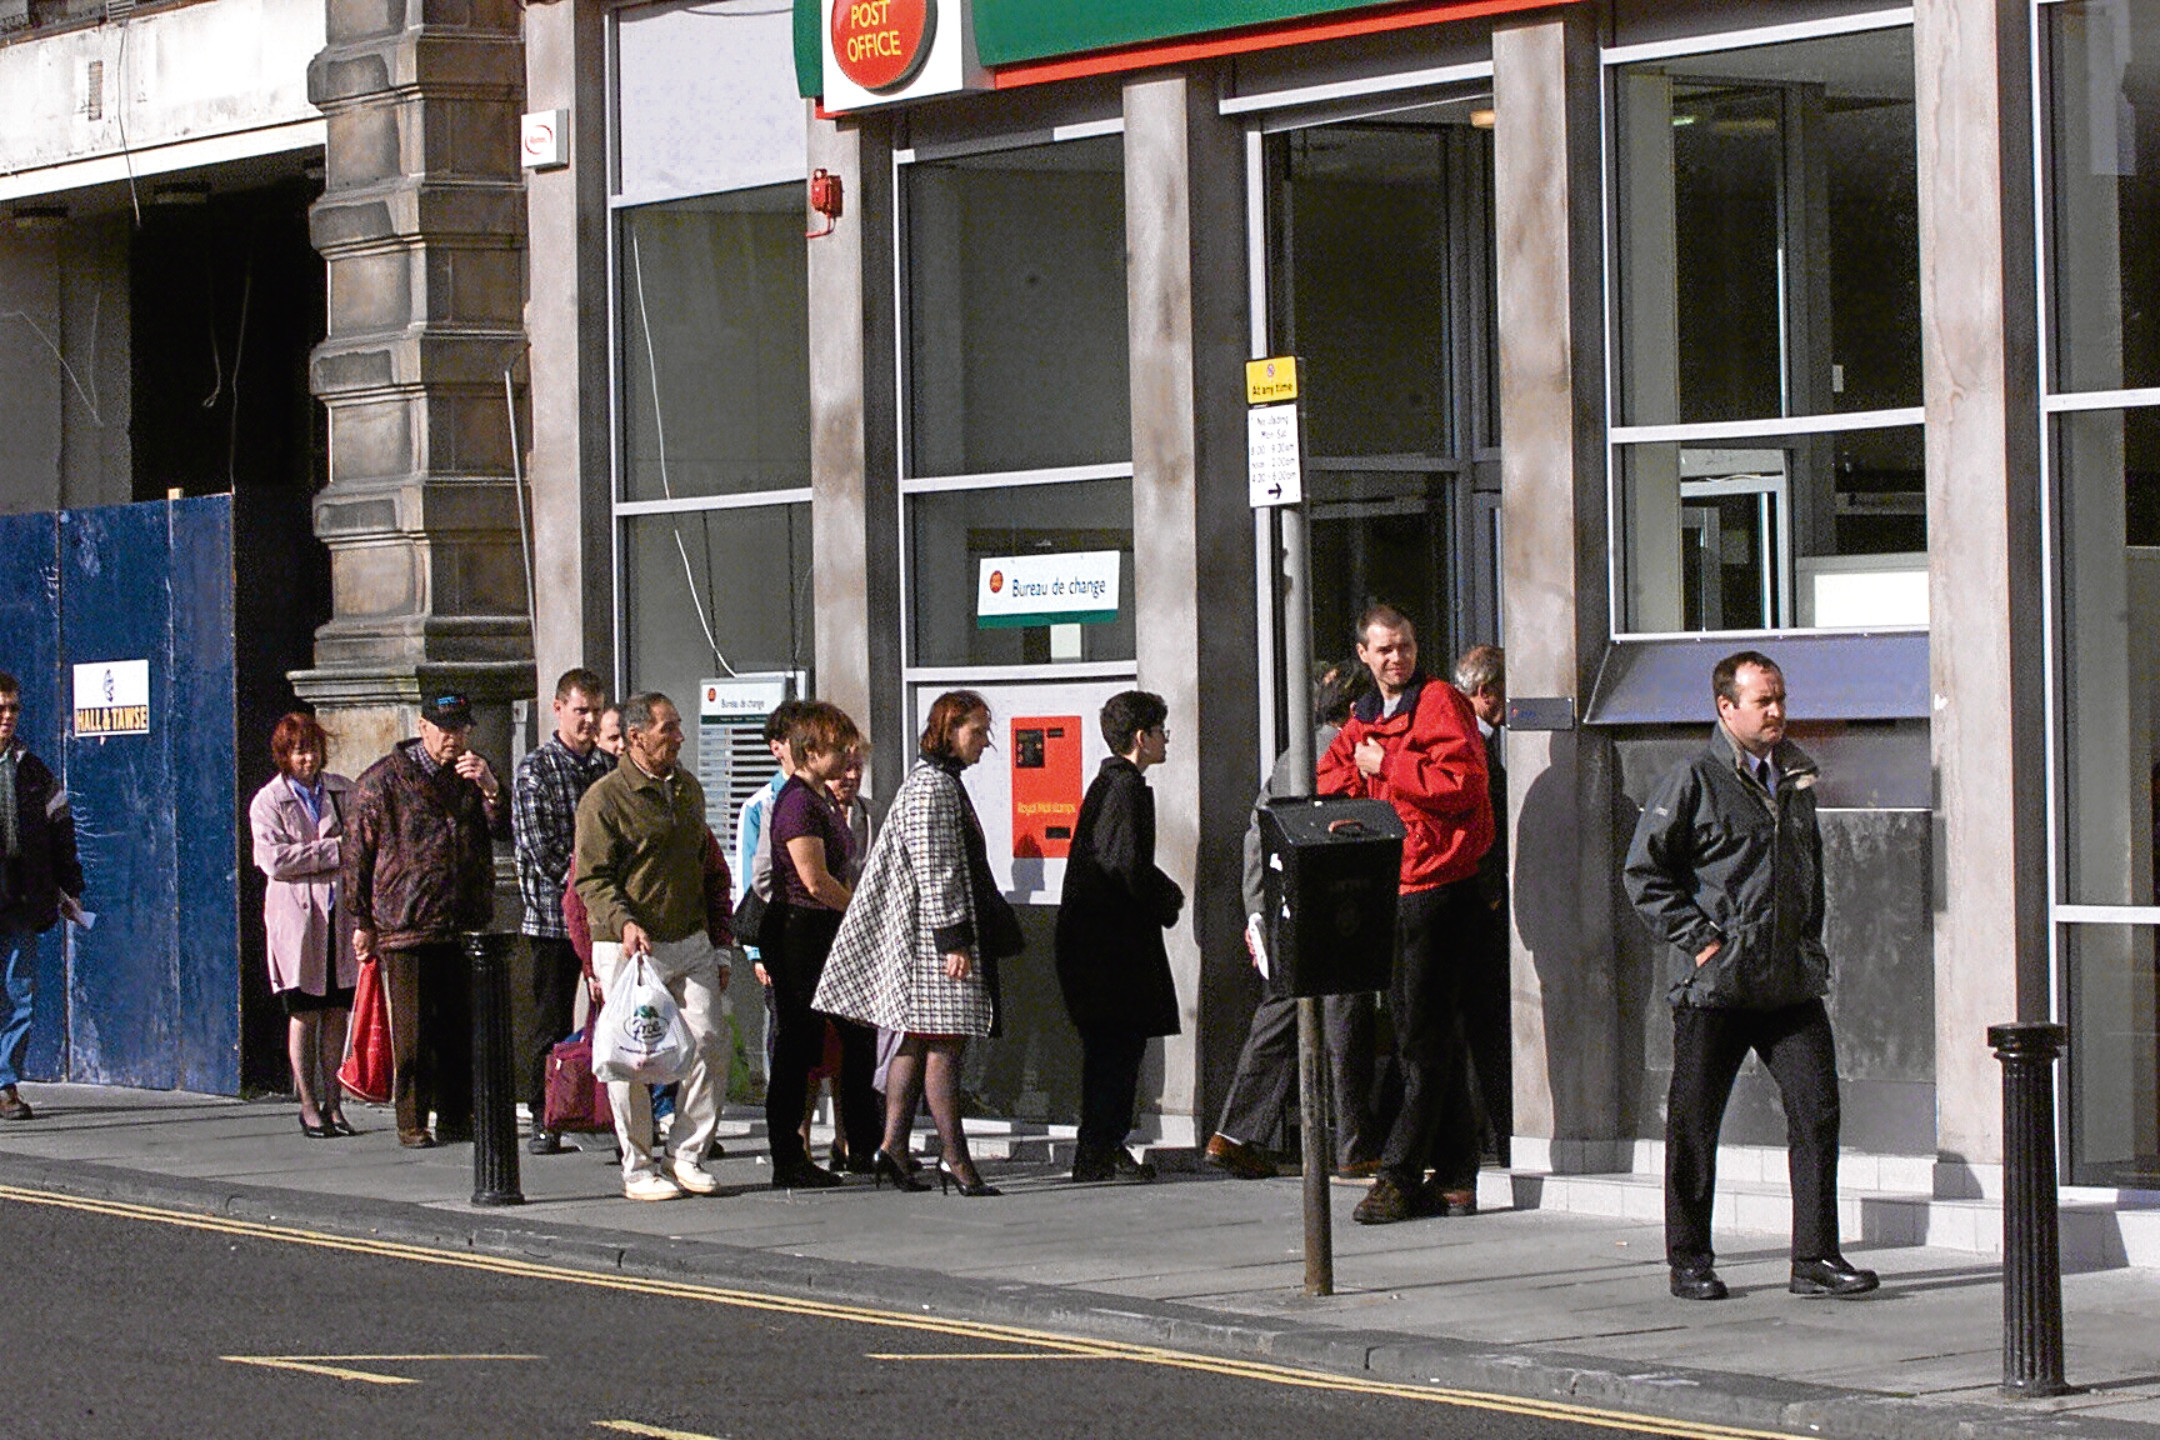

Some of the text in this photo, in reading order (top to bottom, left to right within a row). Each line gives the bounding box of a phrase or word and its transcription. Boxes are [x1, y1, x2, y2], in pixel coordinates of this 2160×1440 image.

[852, 1, 890, 29] POST
[847, 30, 902, 62] OFFICE
[1276, 383, 1293, 392] time
[1012, 578, 1048, 597] Bureau
[1052, 576, 1065, 596] de
[1069, 575, 1105, 600] change
[76, 706, 147, 732] HALL & TAWSE
